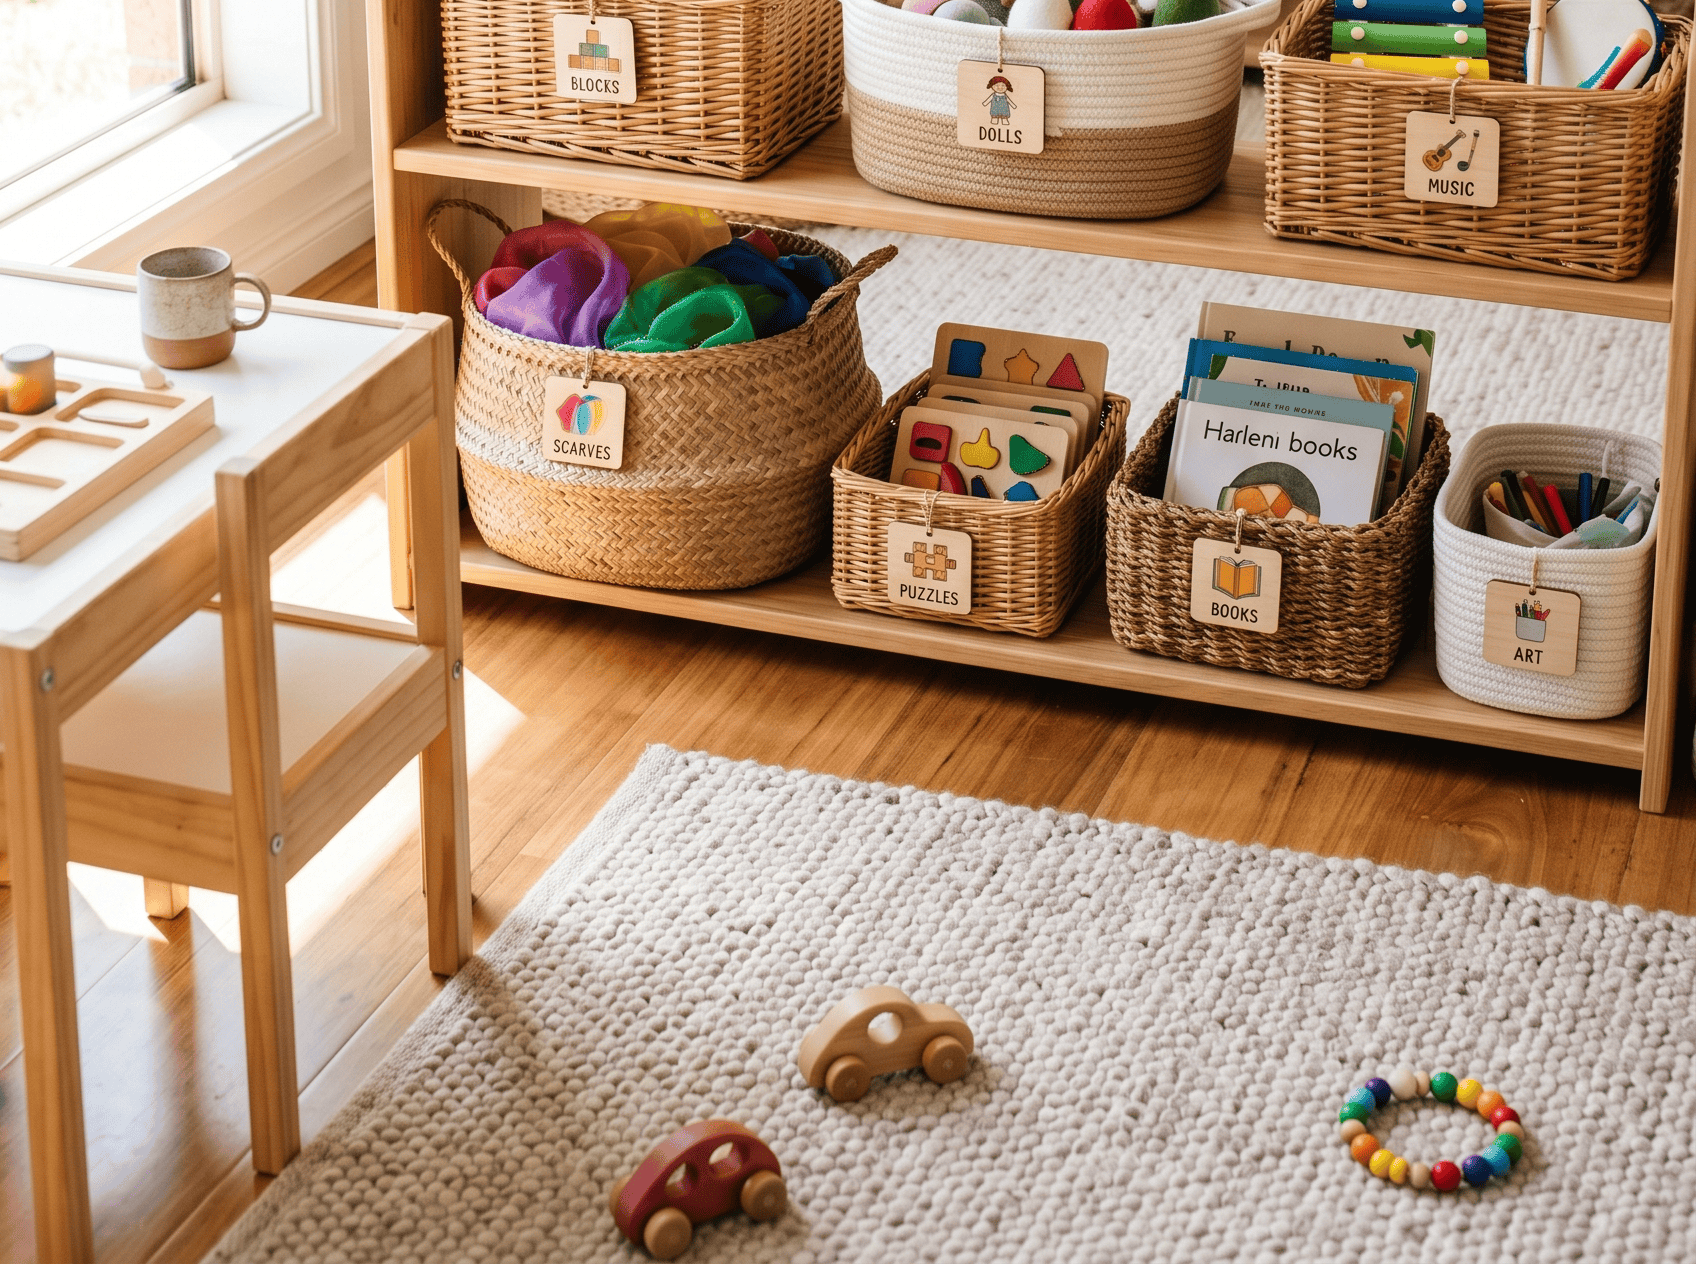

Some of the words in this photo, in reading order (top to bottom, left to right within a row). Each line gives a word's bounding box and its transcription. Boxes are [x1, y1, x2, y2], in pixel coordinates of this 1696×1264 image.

[571, 76, 620, 94] BLOCKS
[979, 126, 1022, 144] DOLLS
[1428, 178, 1475, 197] MUSIC
[553, 439, 611, 460] SCARVES
[1203, 419, 1280, 450] Harleni
[1288, 431, 1358, 461] books
[900, 583, 959, 606] PUZZLES
[1211, 602, 1258, 623] BOOKS
[1513, 646, 1544, 665] ART
